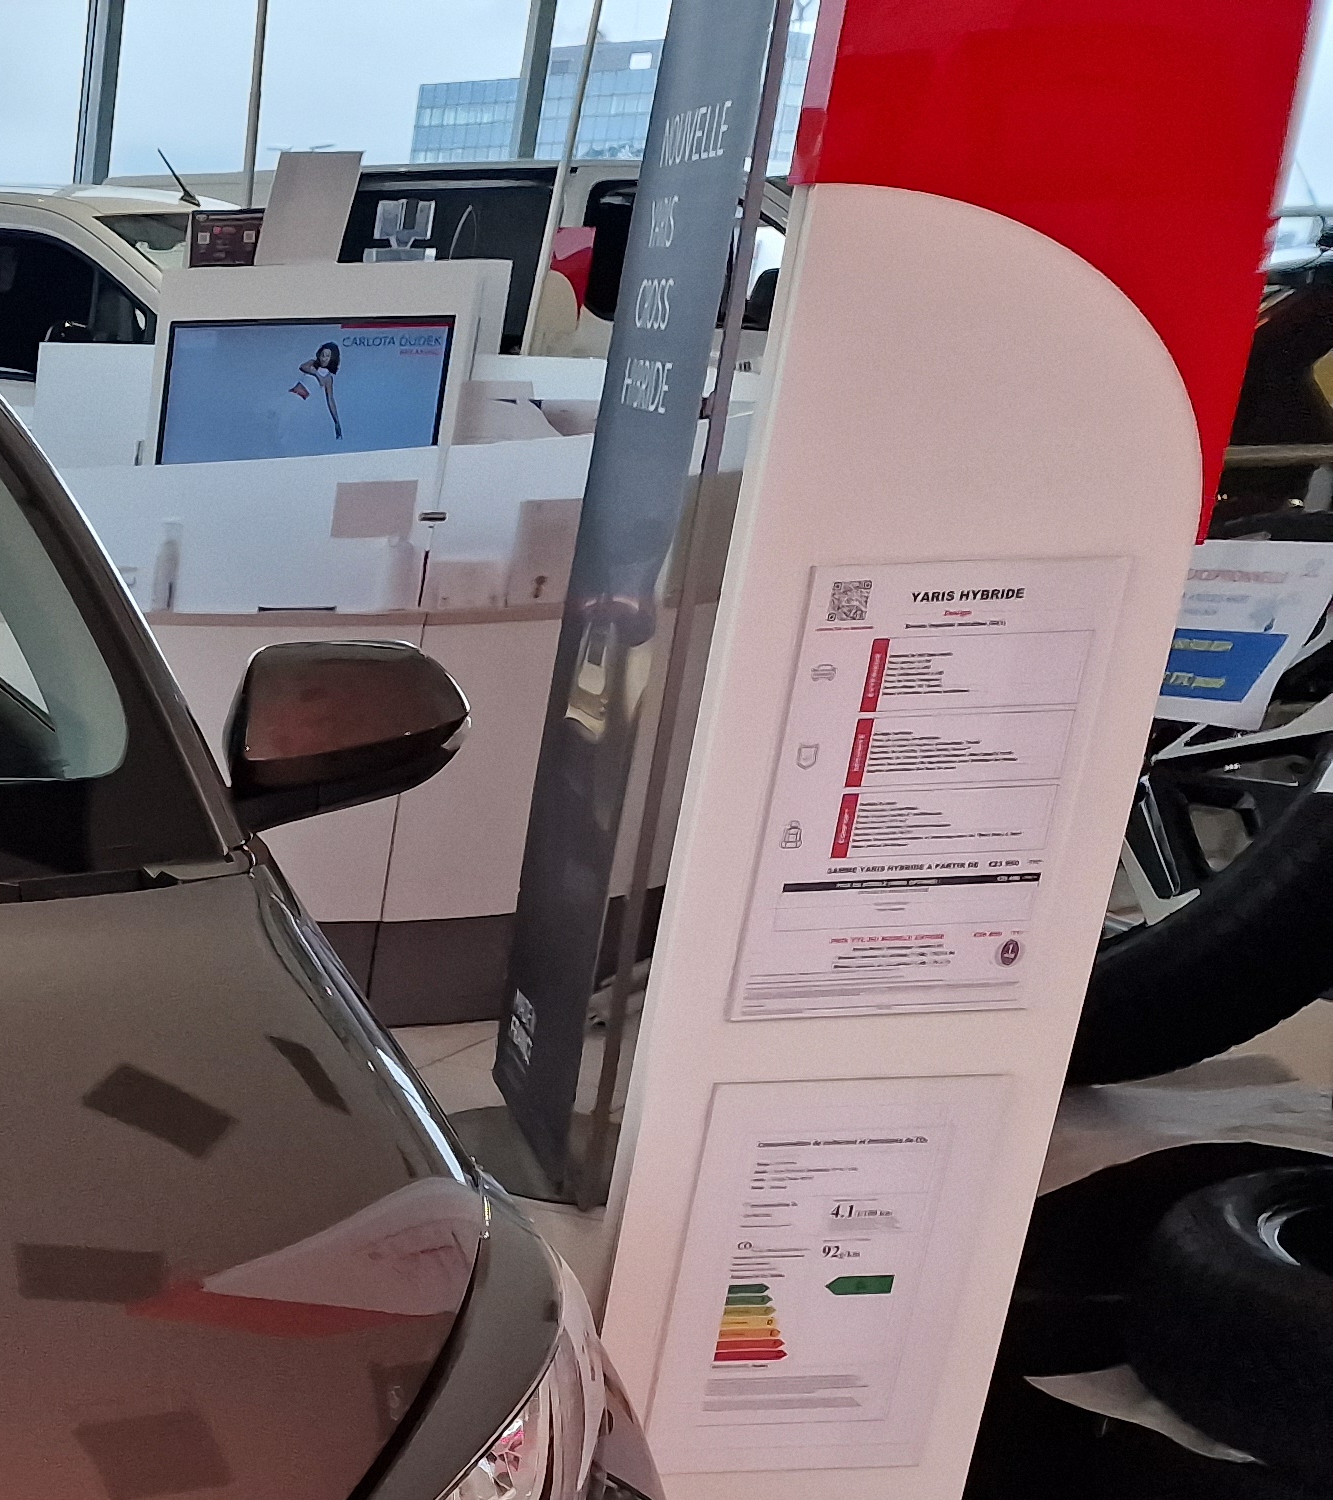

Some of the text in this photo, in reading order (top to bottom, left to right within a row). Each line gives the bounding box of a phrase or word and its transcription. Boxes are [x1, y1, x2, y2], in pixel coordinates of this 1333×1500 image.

[342, 336, 396, 347] CARLOTA
[911, 588, 1025, 603] YARIS HYBRIDE
[830, 1204, 855, 1218] 4.1
